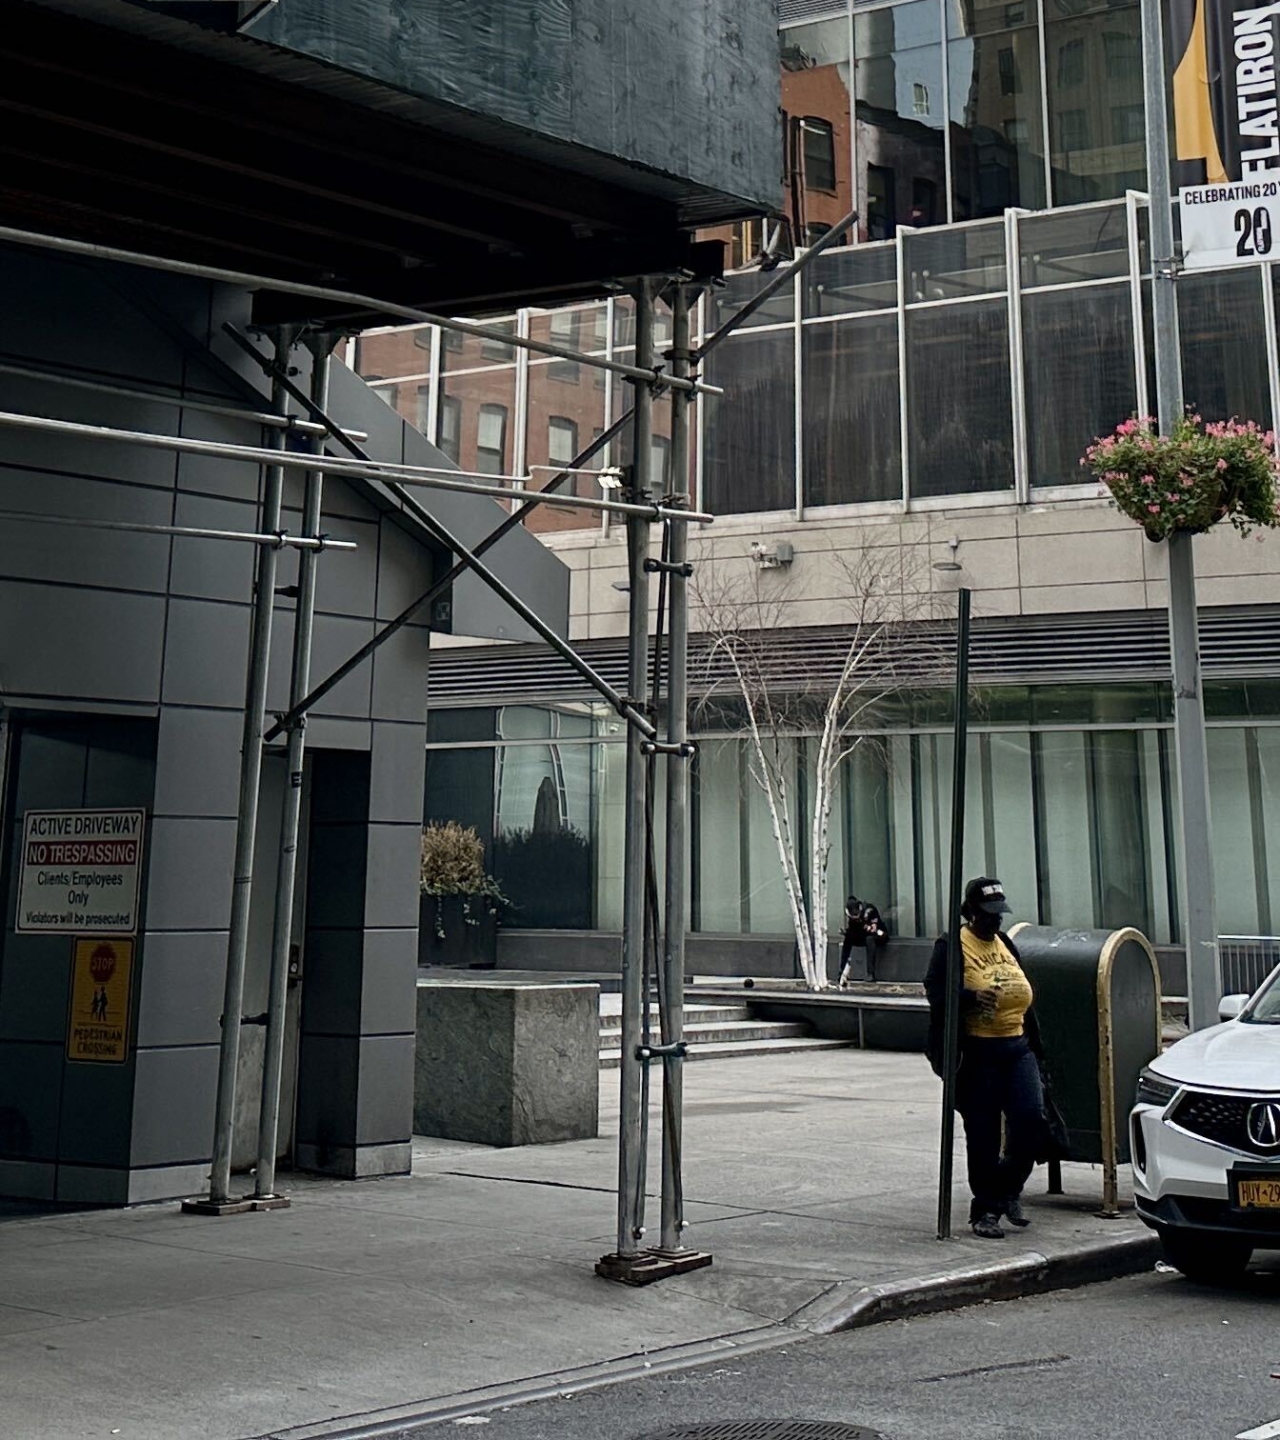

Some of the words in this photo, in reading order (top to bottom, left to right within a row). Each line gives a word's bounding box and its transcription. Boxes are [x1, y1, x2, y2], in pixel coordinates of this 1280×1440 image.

[1232, 10, 1280, 178] FLATIRON
[1184, 184, 1261, 205] CELEBRATING
[1262, 182, 1277, 197] 20
[1234, 206, 1272, 257] 20
[29, 817, 72, 835] ACTIVE
[74, 815, 139, 835] DRIVEWAY
[29, 847, 48, 864] NO
[49, 843, 135, 864] TRESPASSING
[37, 871, 123, 889] Clients/Employees
[67, 891, 89, 906] Only
[26, 912, 59, 924] Violators
[59, 912, 73, 924] will
[74, 913, 84, 925] be
[85, 913, 130, 928] prosecuted
[92, 957, 114, 971] STOP
[74, 1027, 123, 1042] PEDESTRIAN
[77, 1042, 117, 1056] CROSSING
